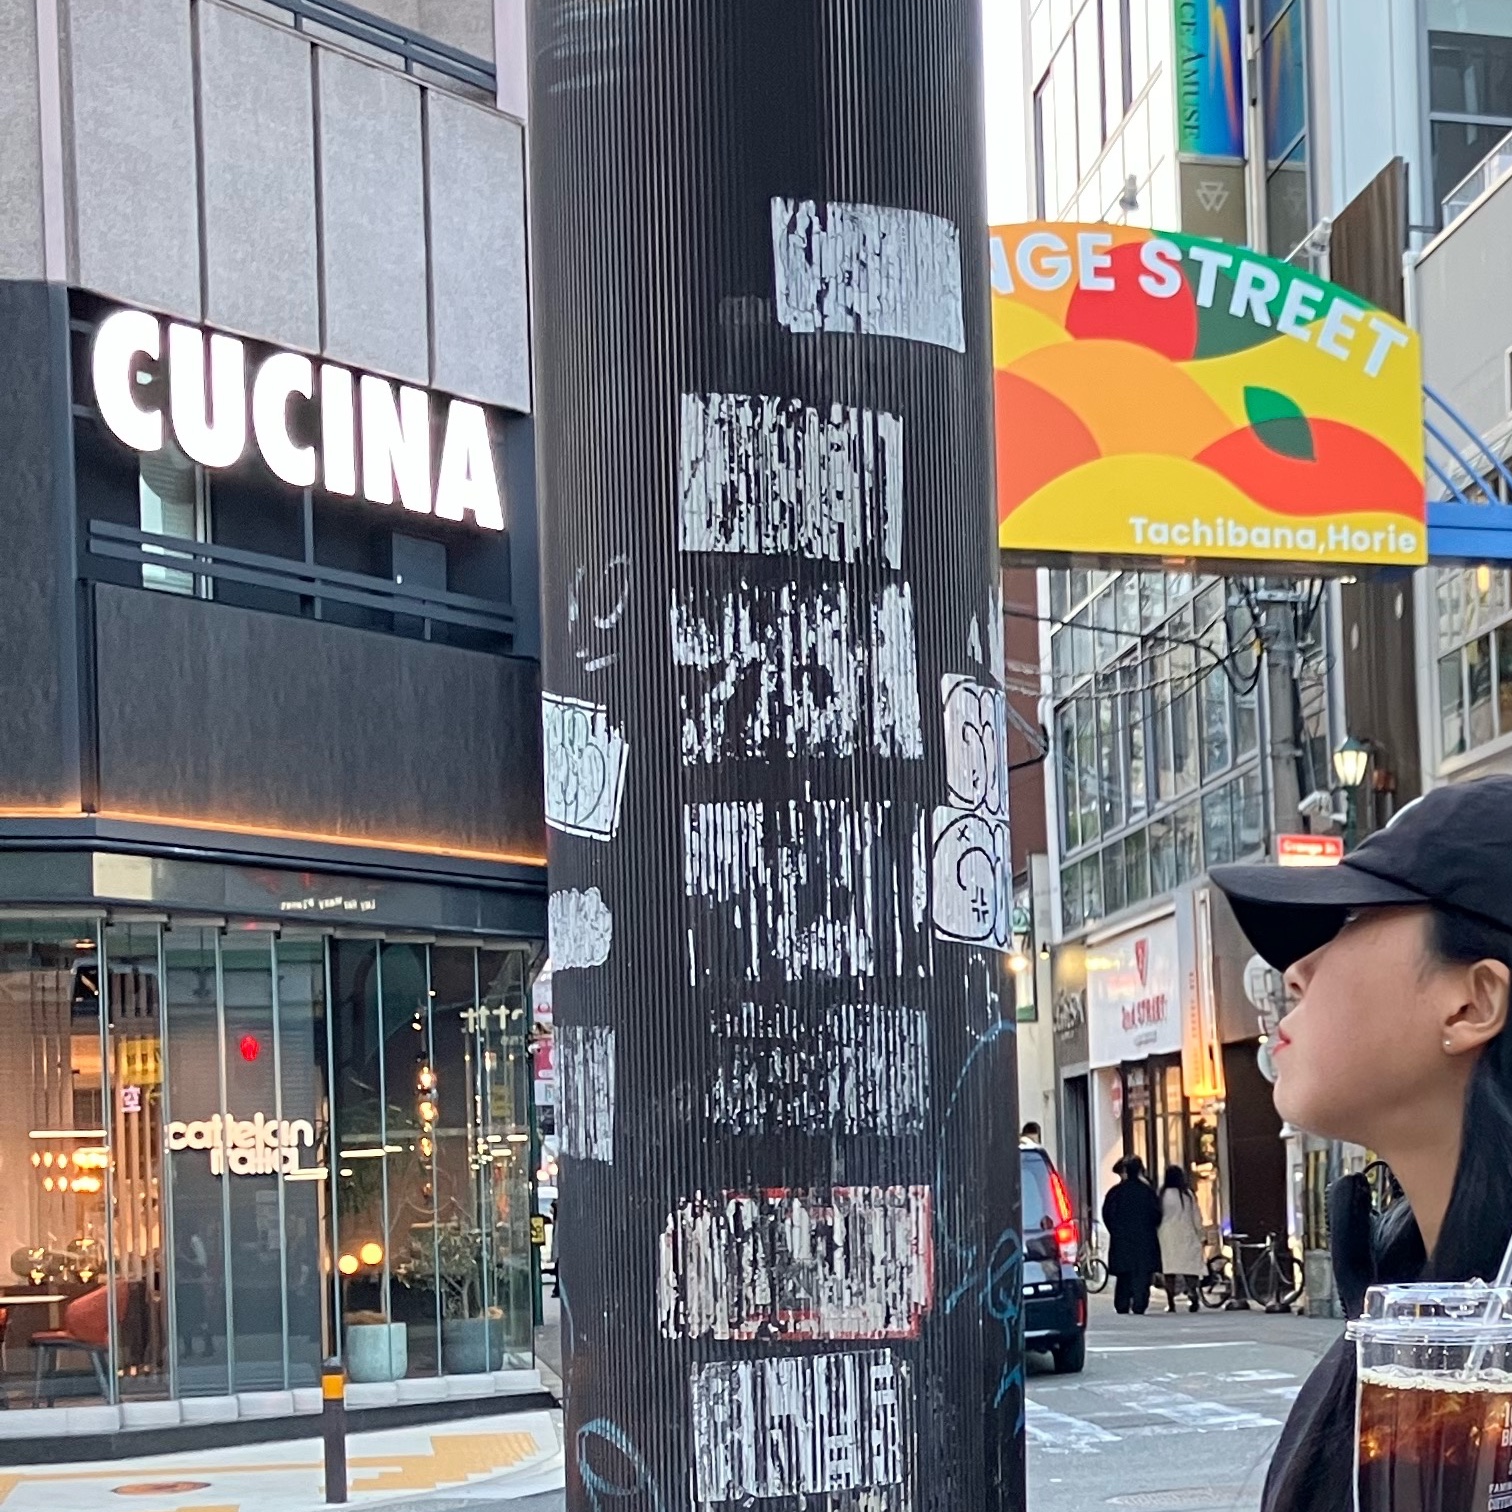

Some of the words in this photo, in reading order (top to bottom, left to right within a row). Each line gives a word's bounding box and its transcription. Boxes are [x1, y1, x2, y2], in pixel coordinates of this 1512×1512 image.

[1181, 47, 1206, 140] AMUSE
[1138, 239, 1409, 378] STREET
[92, 310, 505, 531] CUCINA
